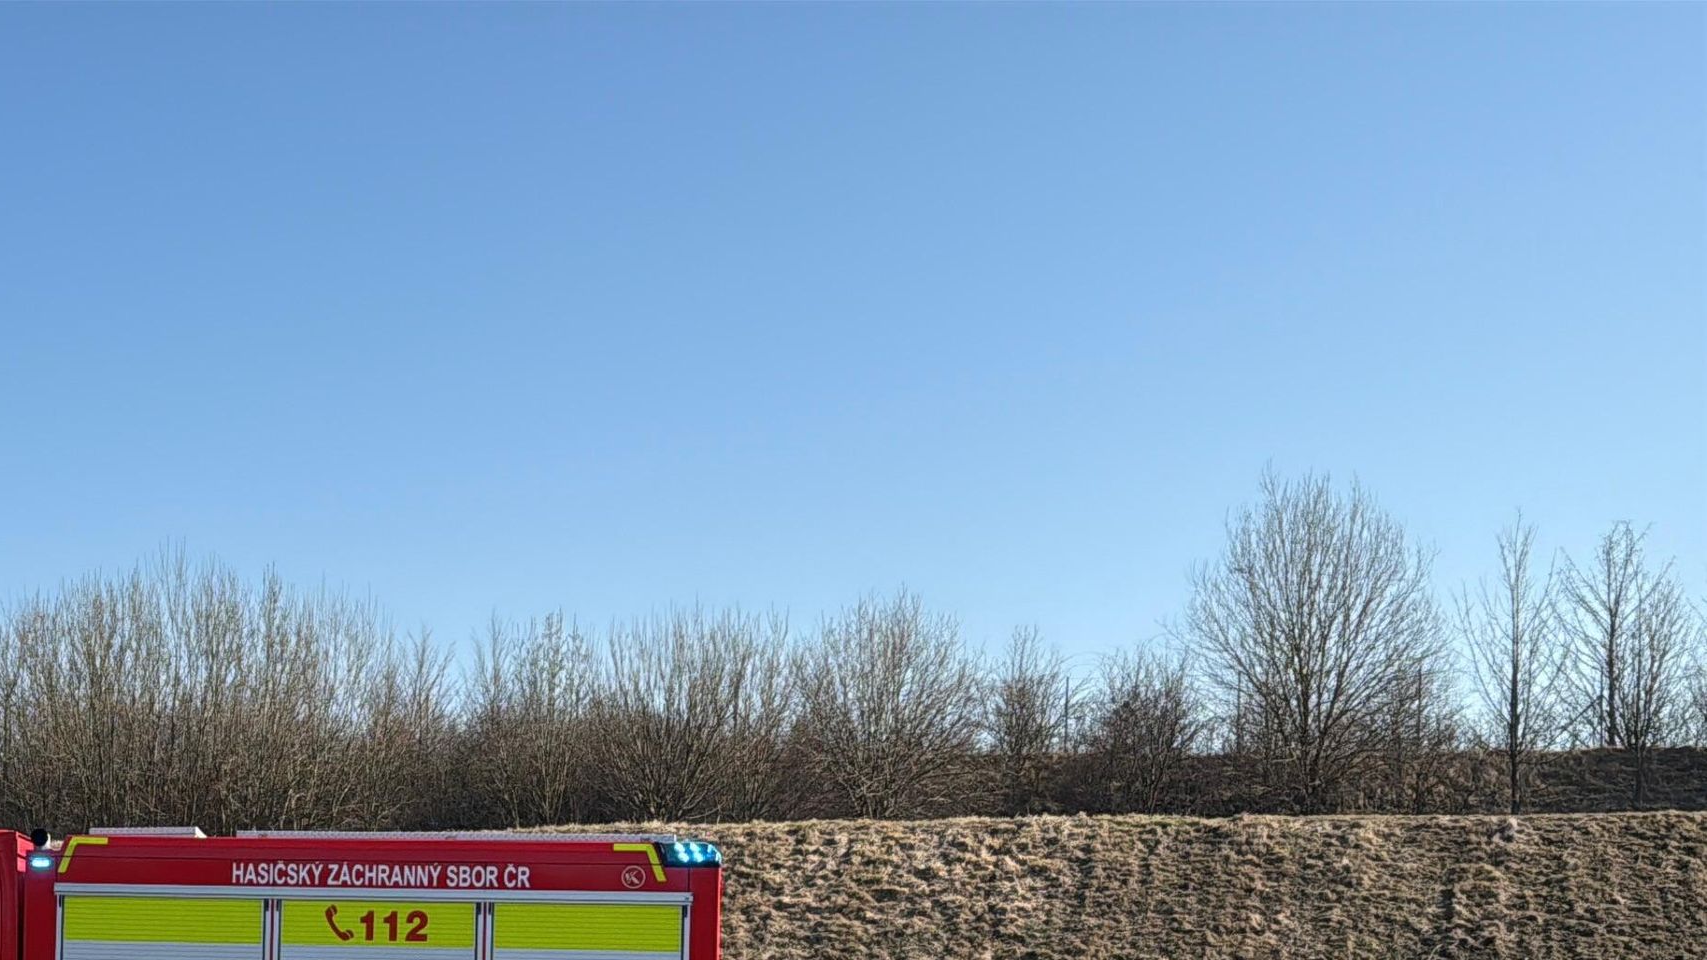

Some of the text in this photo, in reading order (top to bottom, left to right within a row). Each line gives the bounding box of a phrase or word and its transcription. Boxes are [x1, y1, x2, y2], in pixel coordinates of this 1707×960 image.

[232, 861, 530, 888] HASIČSKÝ ZÁCHRANNÝ SBOR ČR
[360, 910, 428, 942] 112
